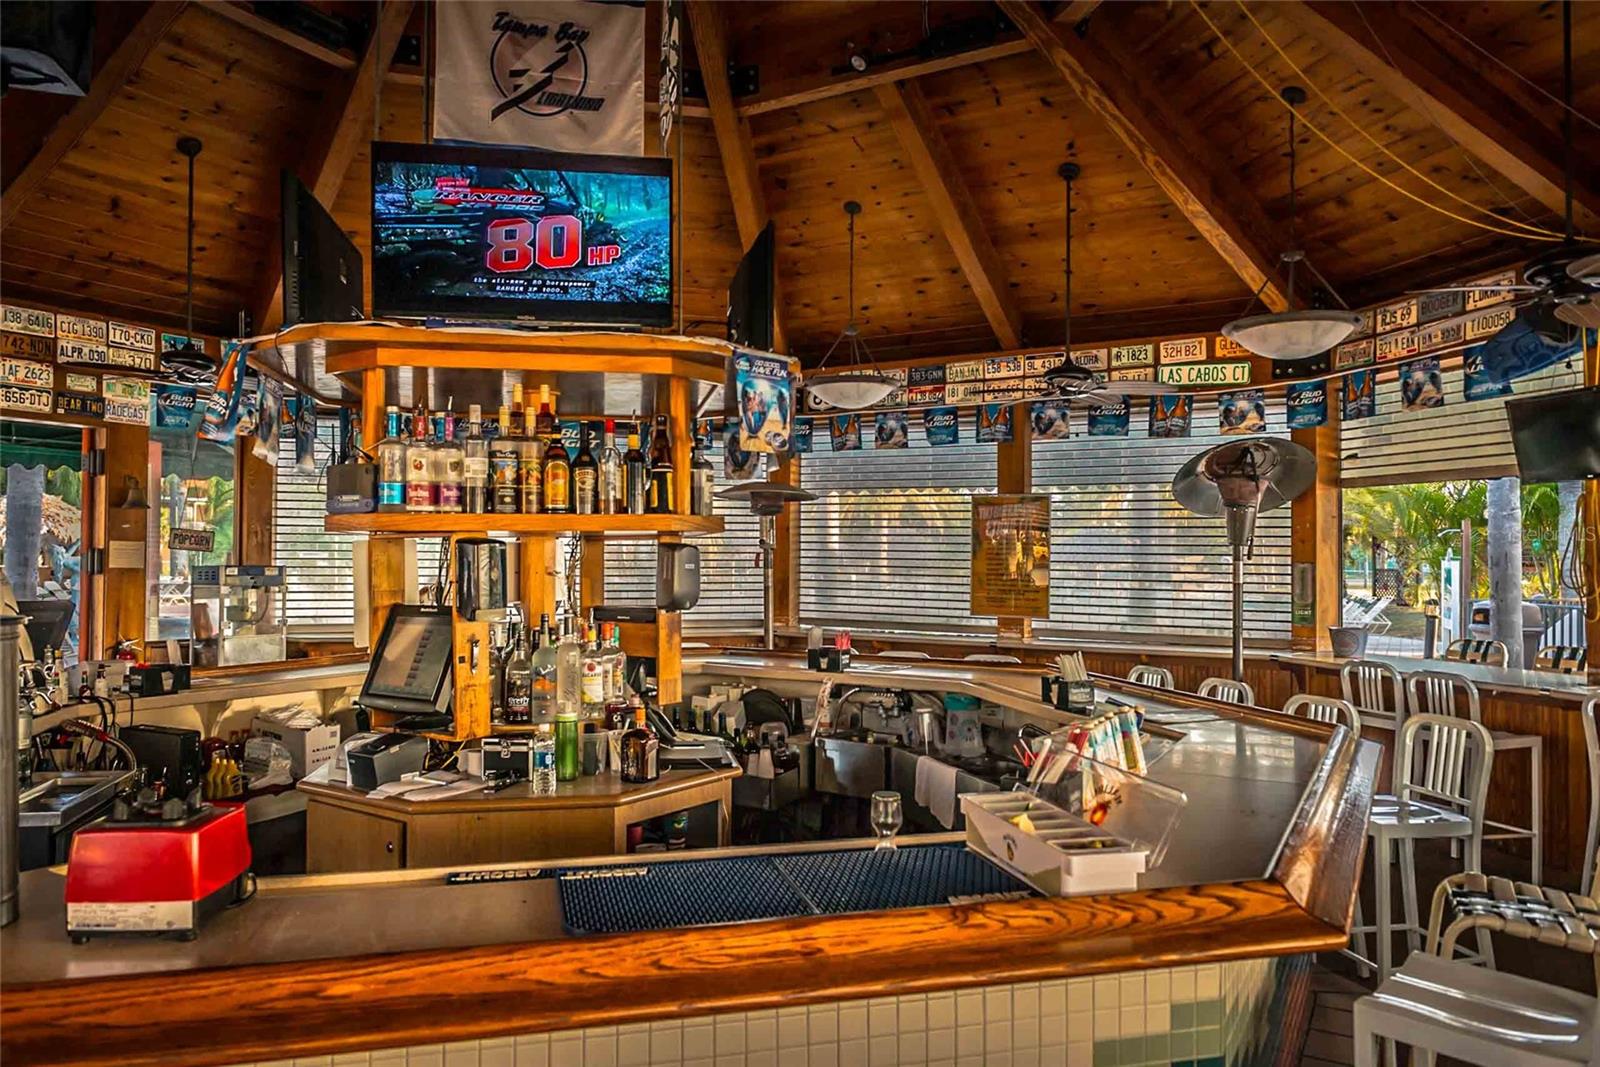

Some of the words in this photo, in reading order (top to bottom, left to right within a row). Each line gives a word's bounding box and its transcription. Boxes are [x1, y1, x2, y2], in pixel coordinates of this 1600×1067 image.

[486, 215, 582, 273] 80
[587, 245, 621, 266] HP
[4, 309, 22, 324] 138
[27, 313, 53, 330] 6416
[60, 320, 79, 335] CIG
[81, 323, 105, 340] 1390
[59, 344, 83, 360] ALPR
[128, 354, 152, 370] 370
[24, 366, 51, 381] 2623
[751, 365, 772, 376] HAVE
[1160, 367, 1183, 384] LAS
[1187, 366, 1227, 383] CABOS
[1232, 365, 1248, 382] CT
[170, 393, 194, 403] BUD
[1295, 396, 1325, 406] LIGHT
[1300, 389, 1323, 398] BUD
[58, 396, 82, 411] BEAR
[86, 400, 104, 413] TWO
[165, 399, 195, 409] LIGHT
[928, 420, 955, 428] LIGHT
[173, 532, 212, 547] POPCORN
